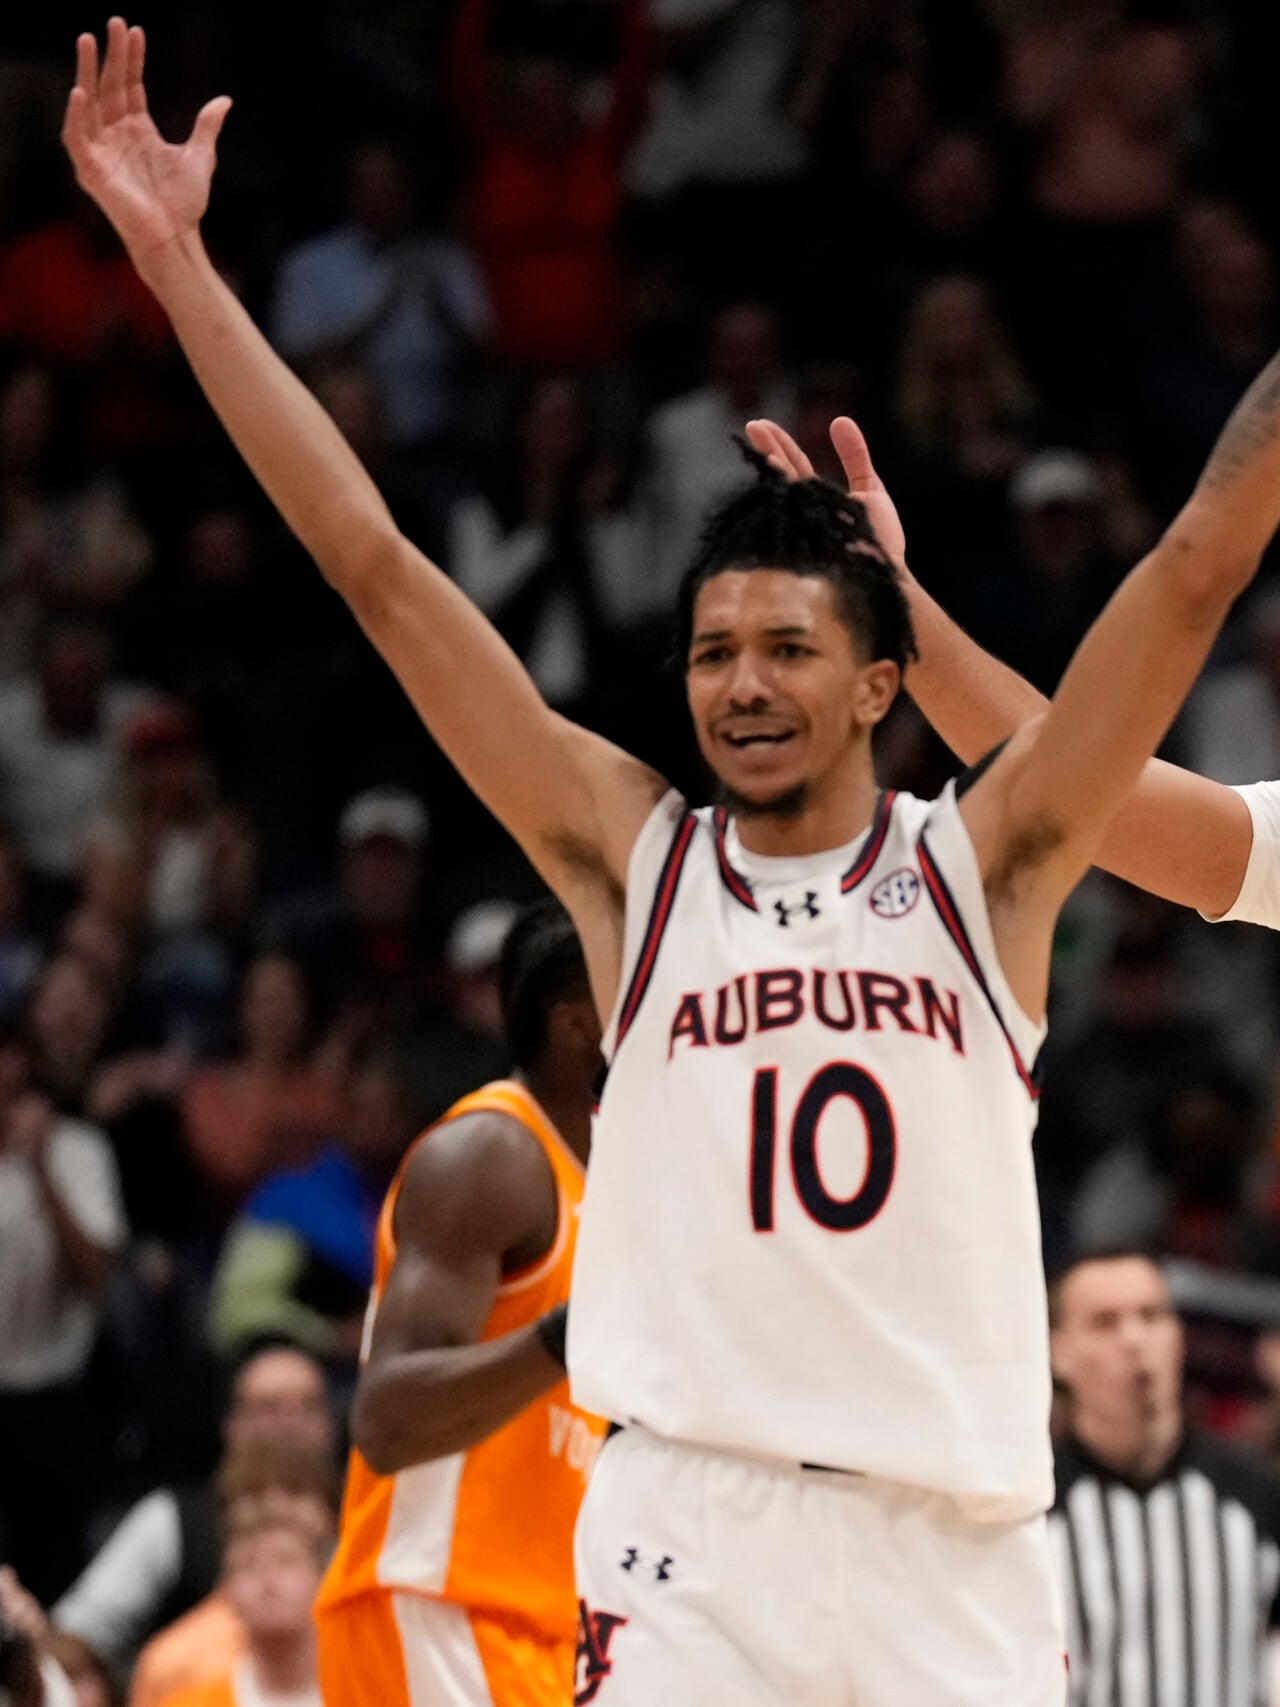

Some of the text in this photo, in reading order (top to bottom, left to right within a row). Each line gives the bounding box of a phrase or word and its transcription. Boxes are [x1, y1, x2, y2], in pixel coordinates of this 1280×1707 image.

[872, 870, 919, 915] SEC
[667, 967, 967, 1063] AUBURN
[748, 1060, 897, 1233] 10
